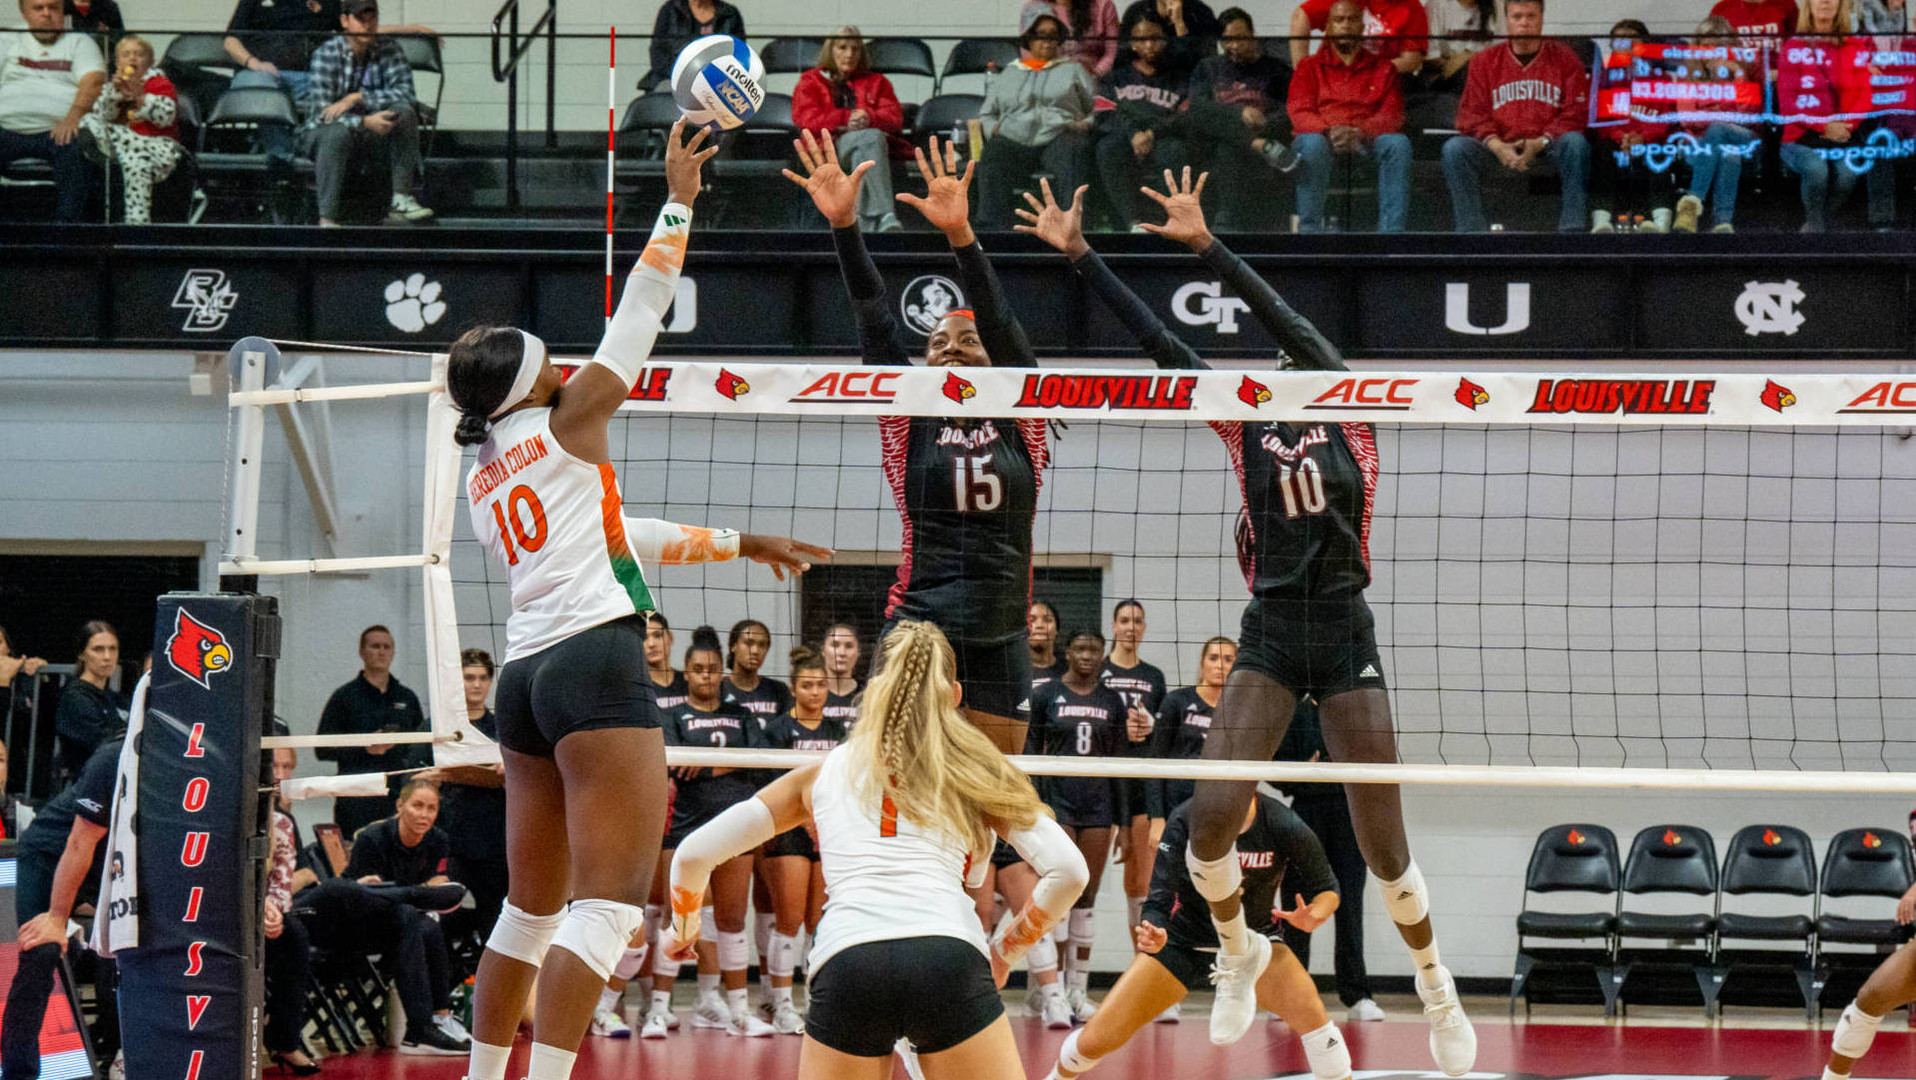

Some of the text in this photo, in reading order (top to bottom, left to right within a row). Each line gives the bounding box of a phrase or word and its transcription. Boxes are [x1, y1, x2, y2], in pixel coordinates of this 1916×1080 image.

[716, 80, 750, 115] NCAA
[726, 64, 761, 104] molten
[1492, 80, 1561, 110] LOUISVILLE
[1171, 281, 1252, 334] GT
[1445, 282, 1530, 336] U
[796, 372, 903, 397] ACC
[1013, 373, 1199, 412] LOUISVILLE
[1312, 378, 1421, 403] ACC
[1525, 378, 1717, 415] LOUISVILLE
[1848, 382, 1916, 406] AC
[504, 433, 548, 475] COLON
[952, 452, 1003, 512] 15
[1277, 456, 1327, 519] 10
[491, 484, 549, 566] 10
[1076, 721, 1092, 756] 8
